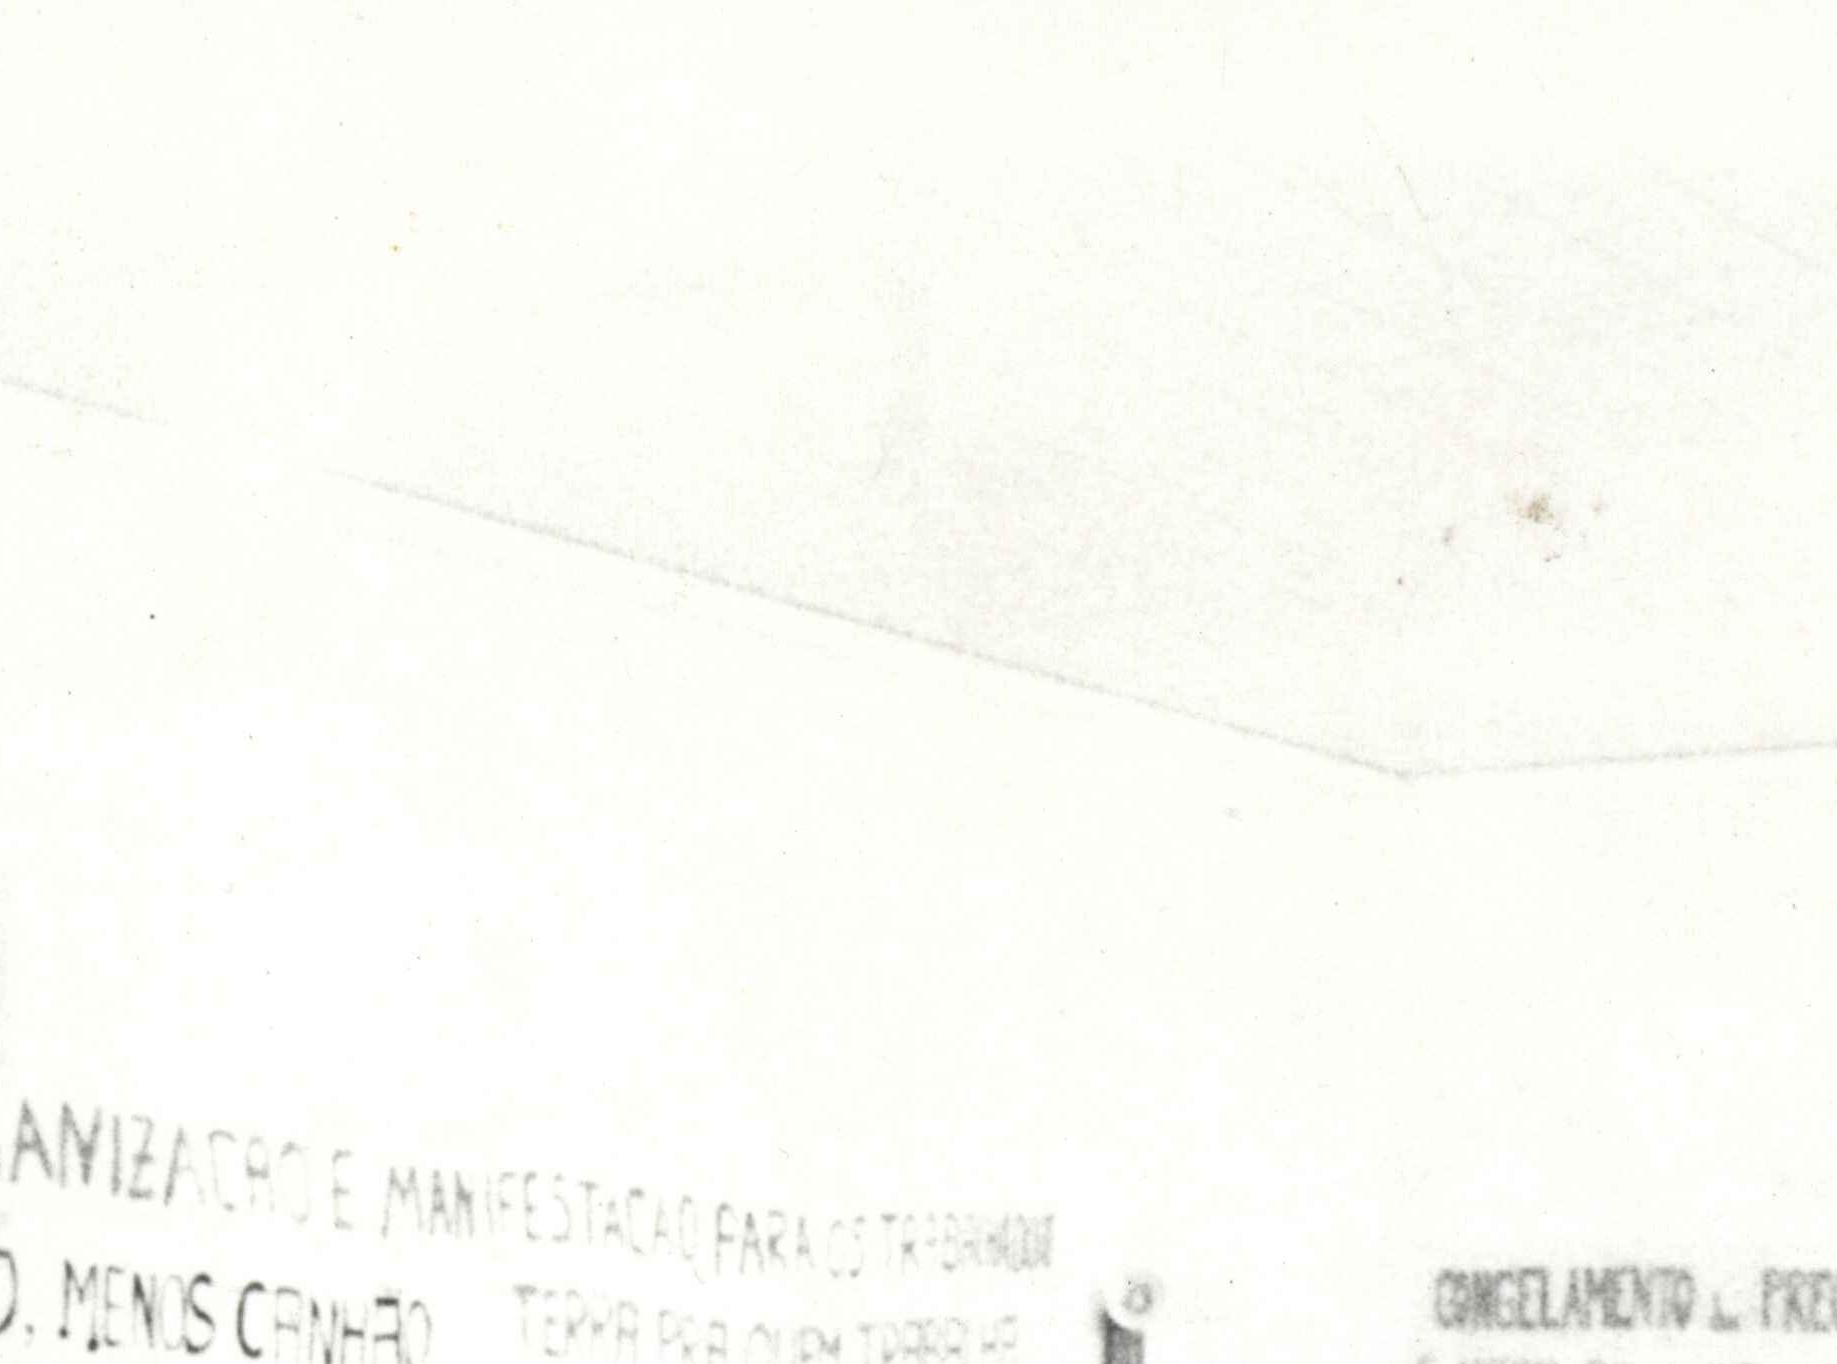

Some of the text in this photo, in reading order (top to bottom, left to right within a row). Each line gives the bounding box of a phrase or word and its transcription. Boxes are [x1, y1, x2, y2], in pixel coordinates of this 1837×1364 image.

[332, 1149, 354, 1230] E
[715, 1201, 814, 1276] PARA
[57, 1258, 216, 1356] MENOS
